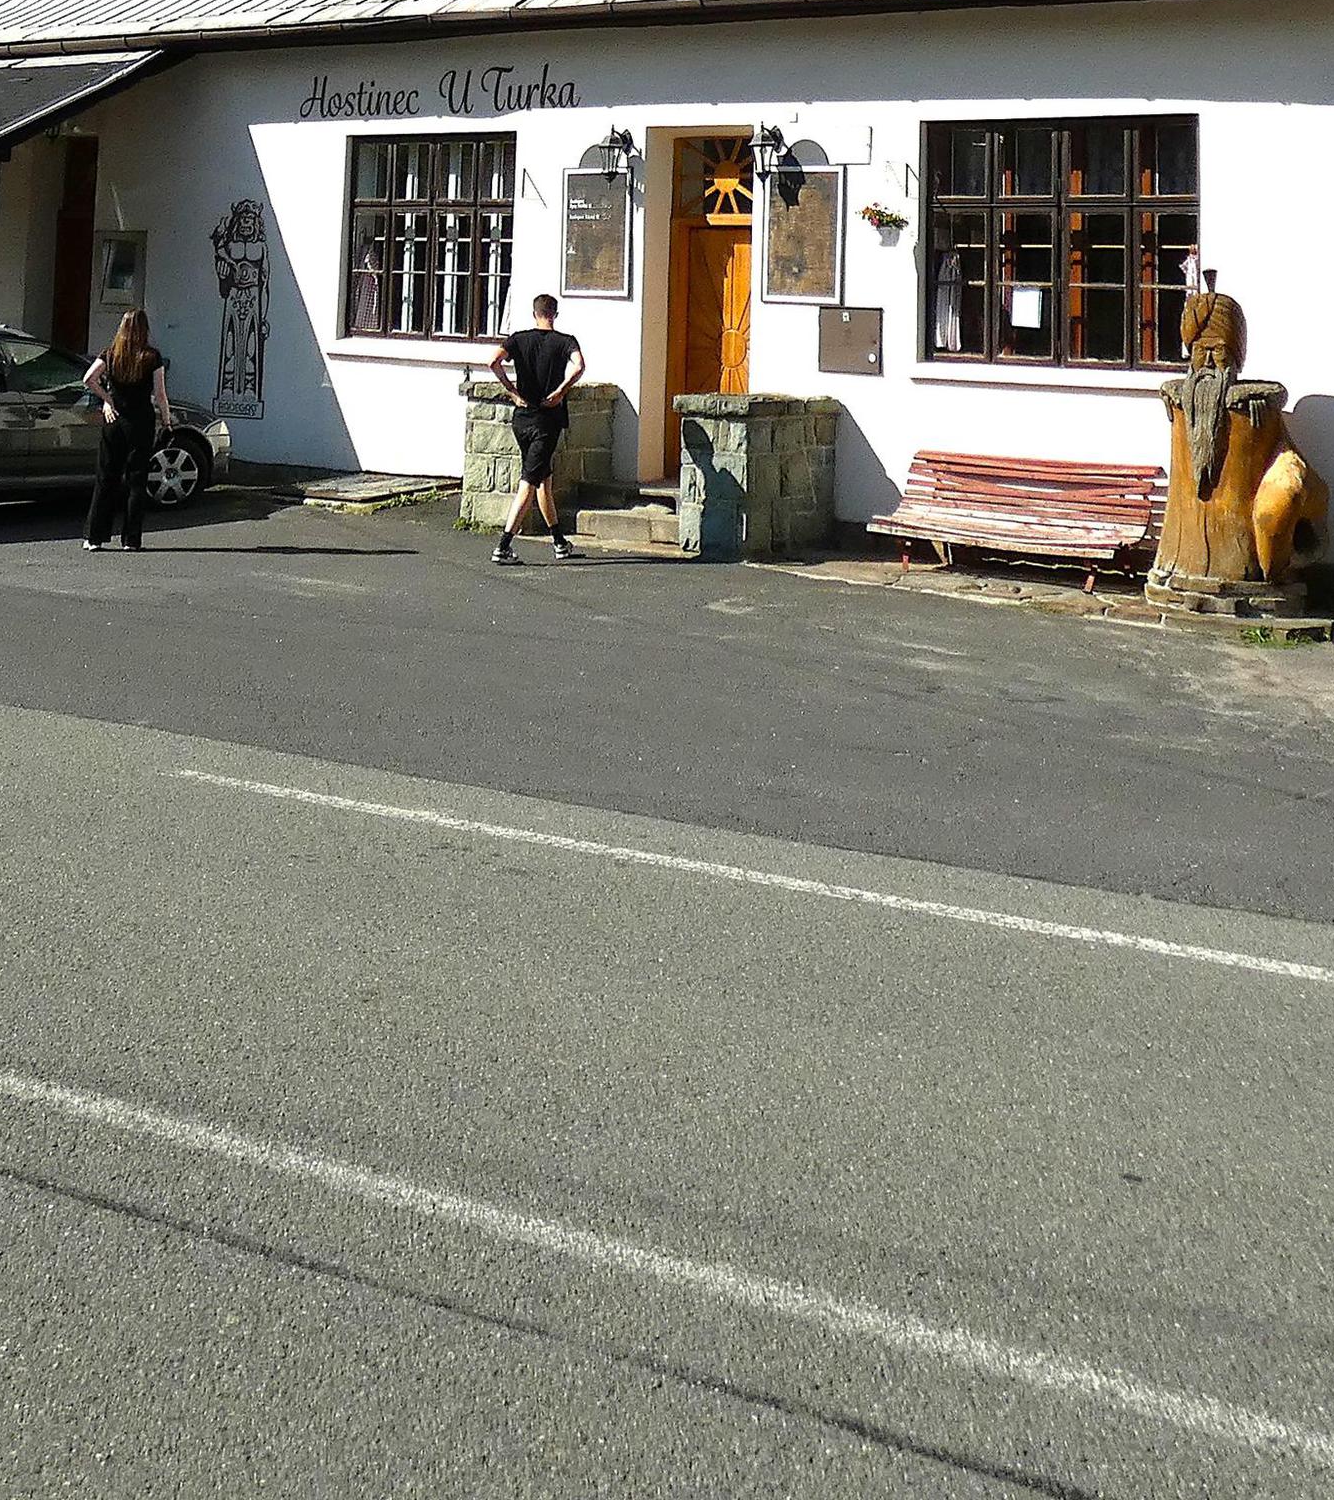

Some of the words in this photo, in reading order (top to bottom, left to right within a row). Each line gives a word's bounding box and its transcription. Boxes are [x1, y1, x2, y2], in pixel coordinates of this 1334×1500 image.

[299, 75, 420, 119] Hostinec
[439, 69, 474, 115] U
[481, 63, 581, 110] Turka
